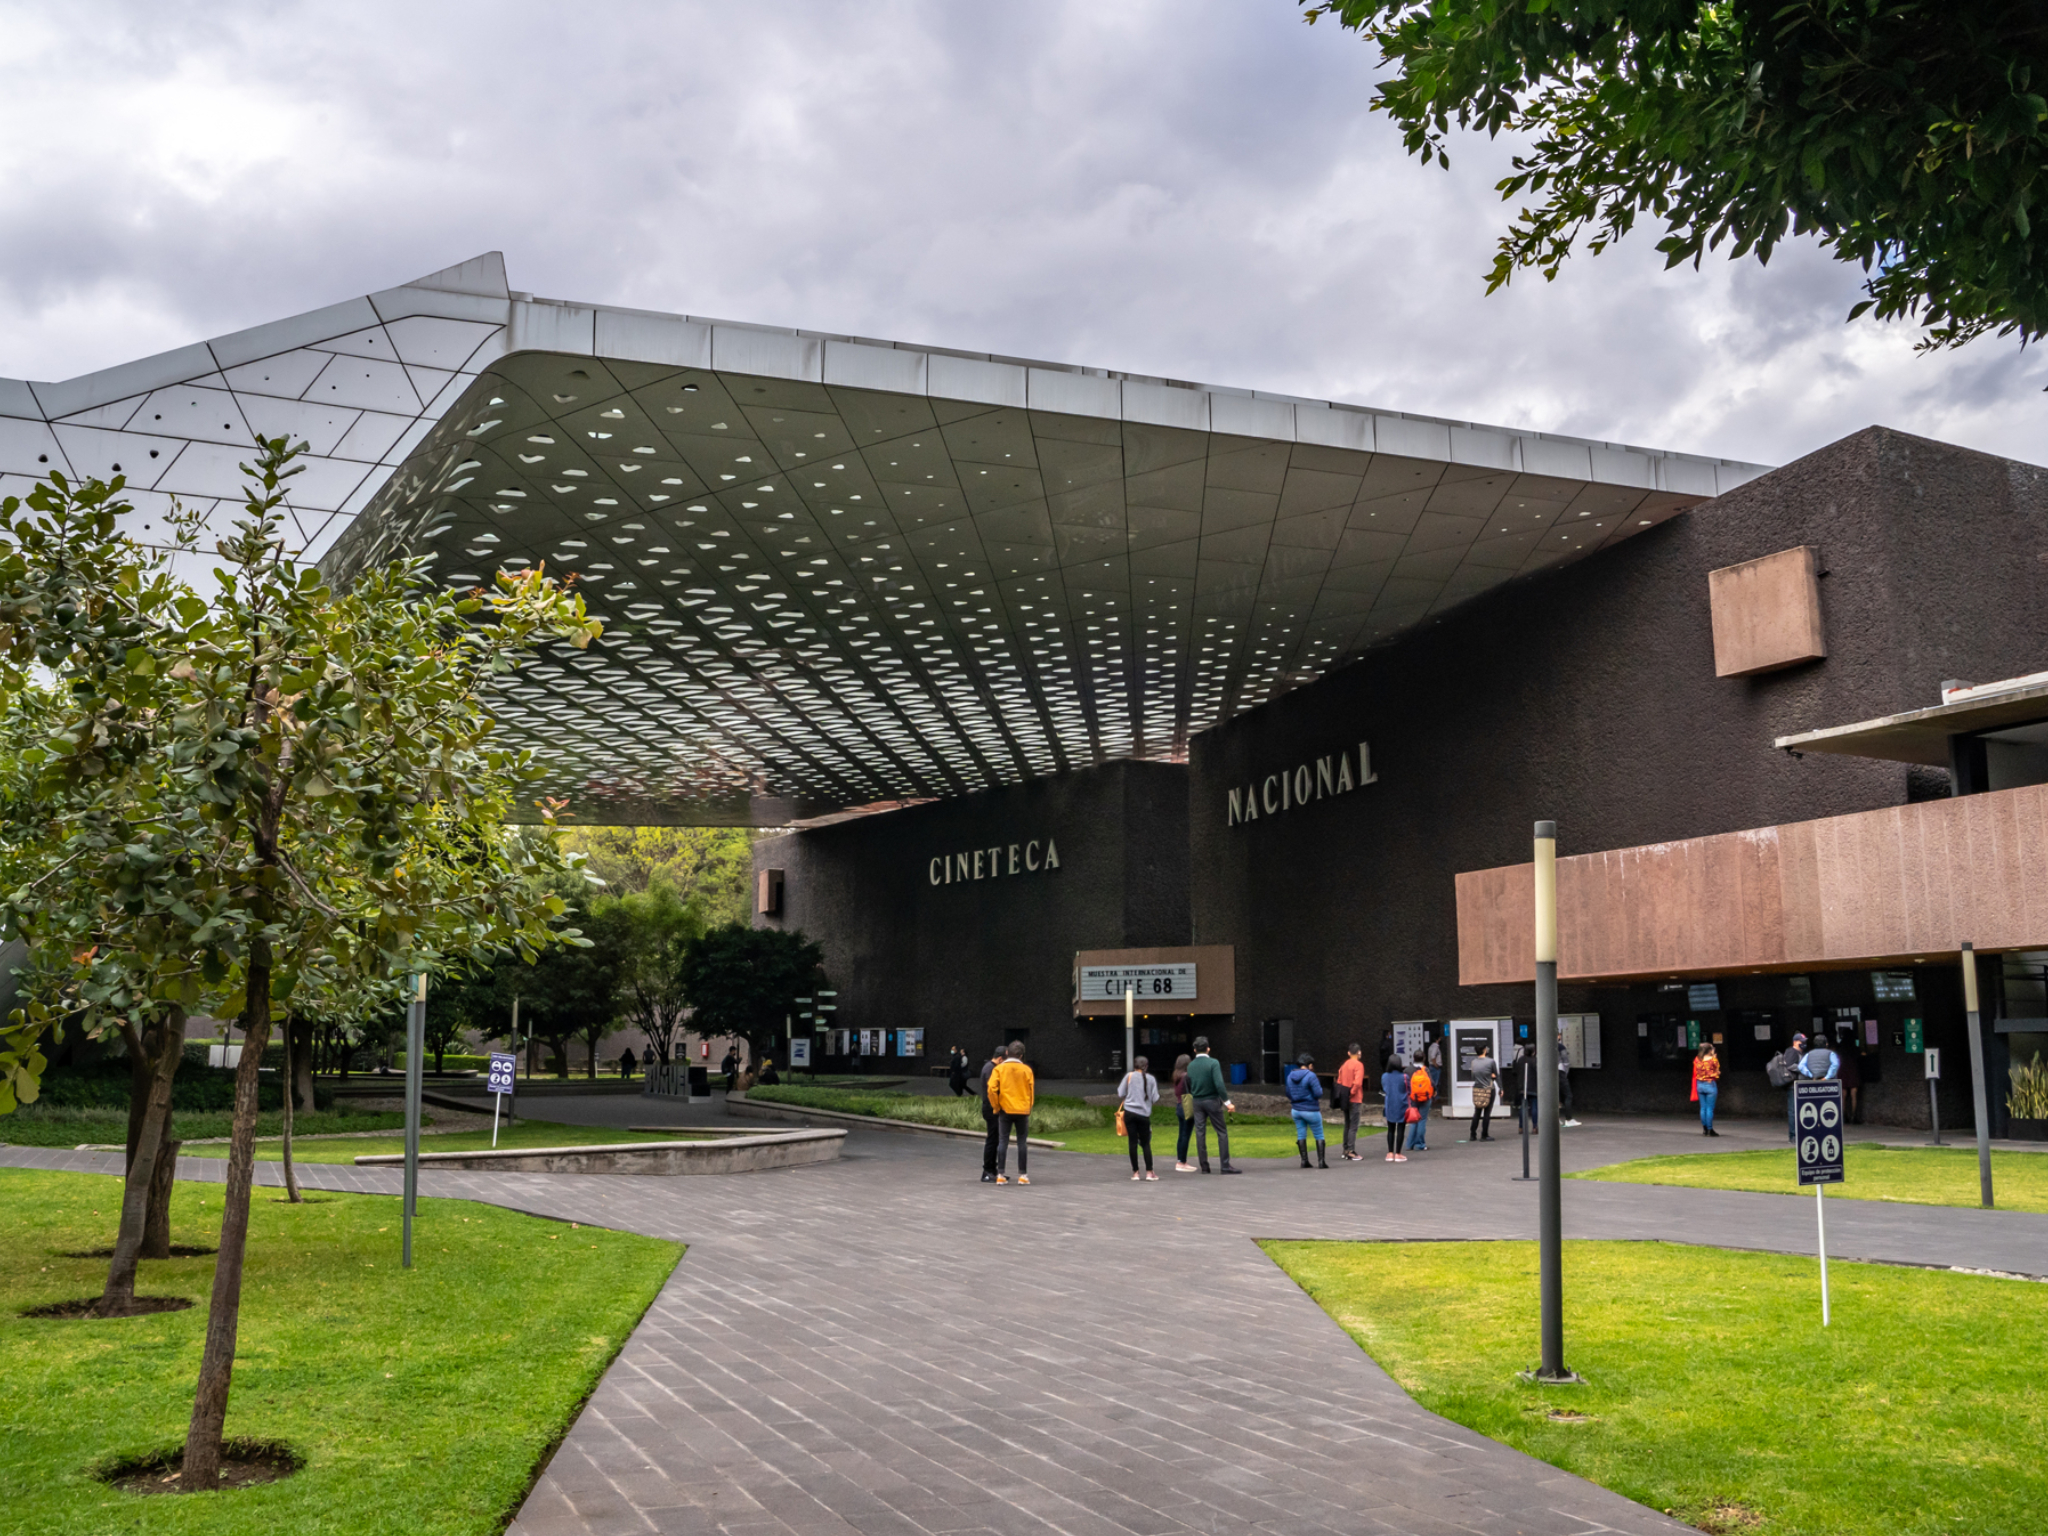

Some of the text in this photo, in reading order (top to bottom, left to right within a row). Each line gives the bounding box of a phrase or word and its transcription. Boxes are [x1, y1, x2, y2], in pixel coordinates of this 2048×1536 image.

[1227, 741, 1378, 826] NACIONAL
[929, 838, 1060, 886] CINETECA
[1122, 968, 1175, 977] INTERNACIONAL
[1105, 978, 1172, 995] CINE 68
[1809, 1086, 1838, 1094] OBLIGATORIO
